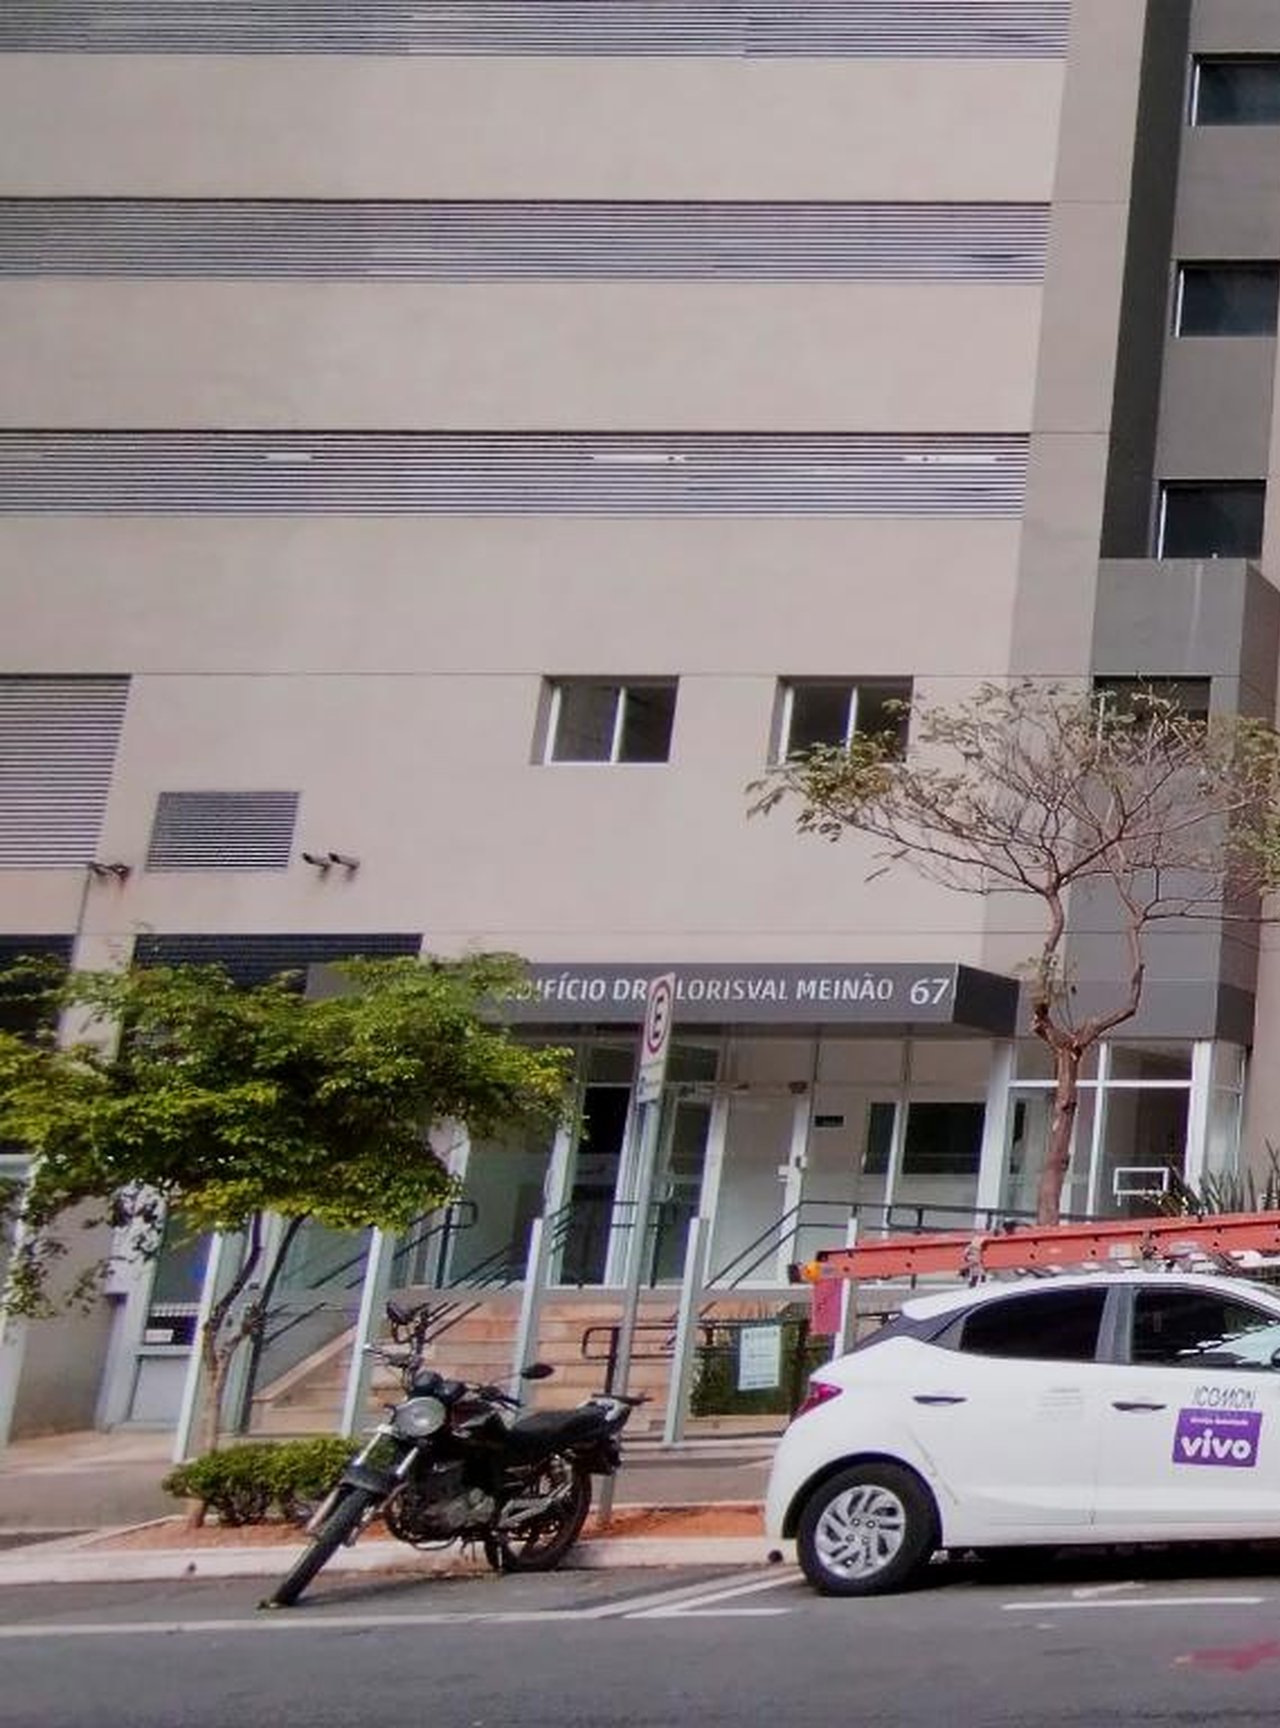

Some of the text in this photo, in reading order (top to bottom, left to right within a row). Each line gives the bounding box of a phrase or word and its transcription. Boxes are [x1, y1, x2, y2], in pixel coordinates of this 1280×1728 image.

[506, 971, 607, 1001] DIFÍCIO
[674, 979, 789, 1001] LORISVAL
[795, 973, 894, 1001] MEINÃO
[909, 977, 950, 1005] 67
[1180, 1428, 1252, 1461] vivo
